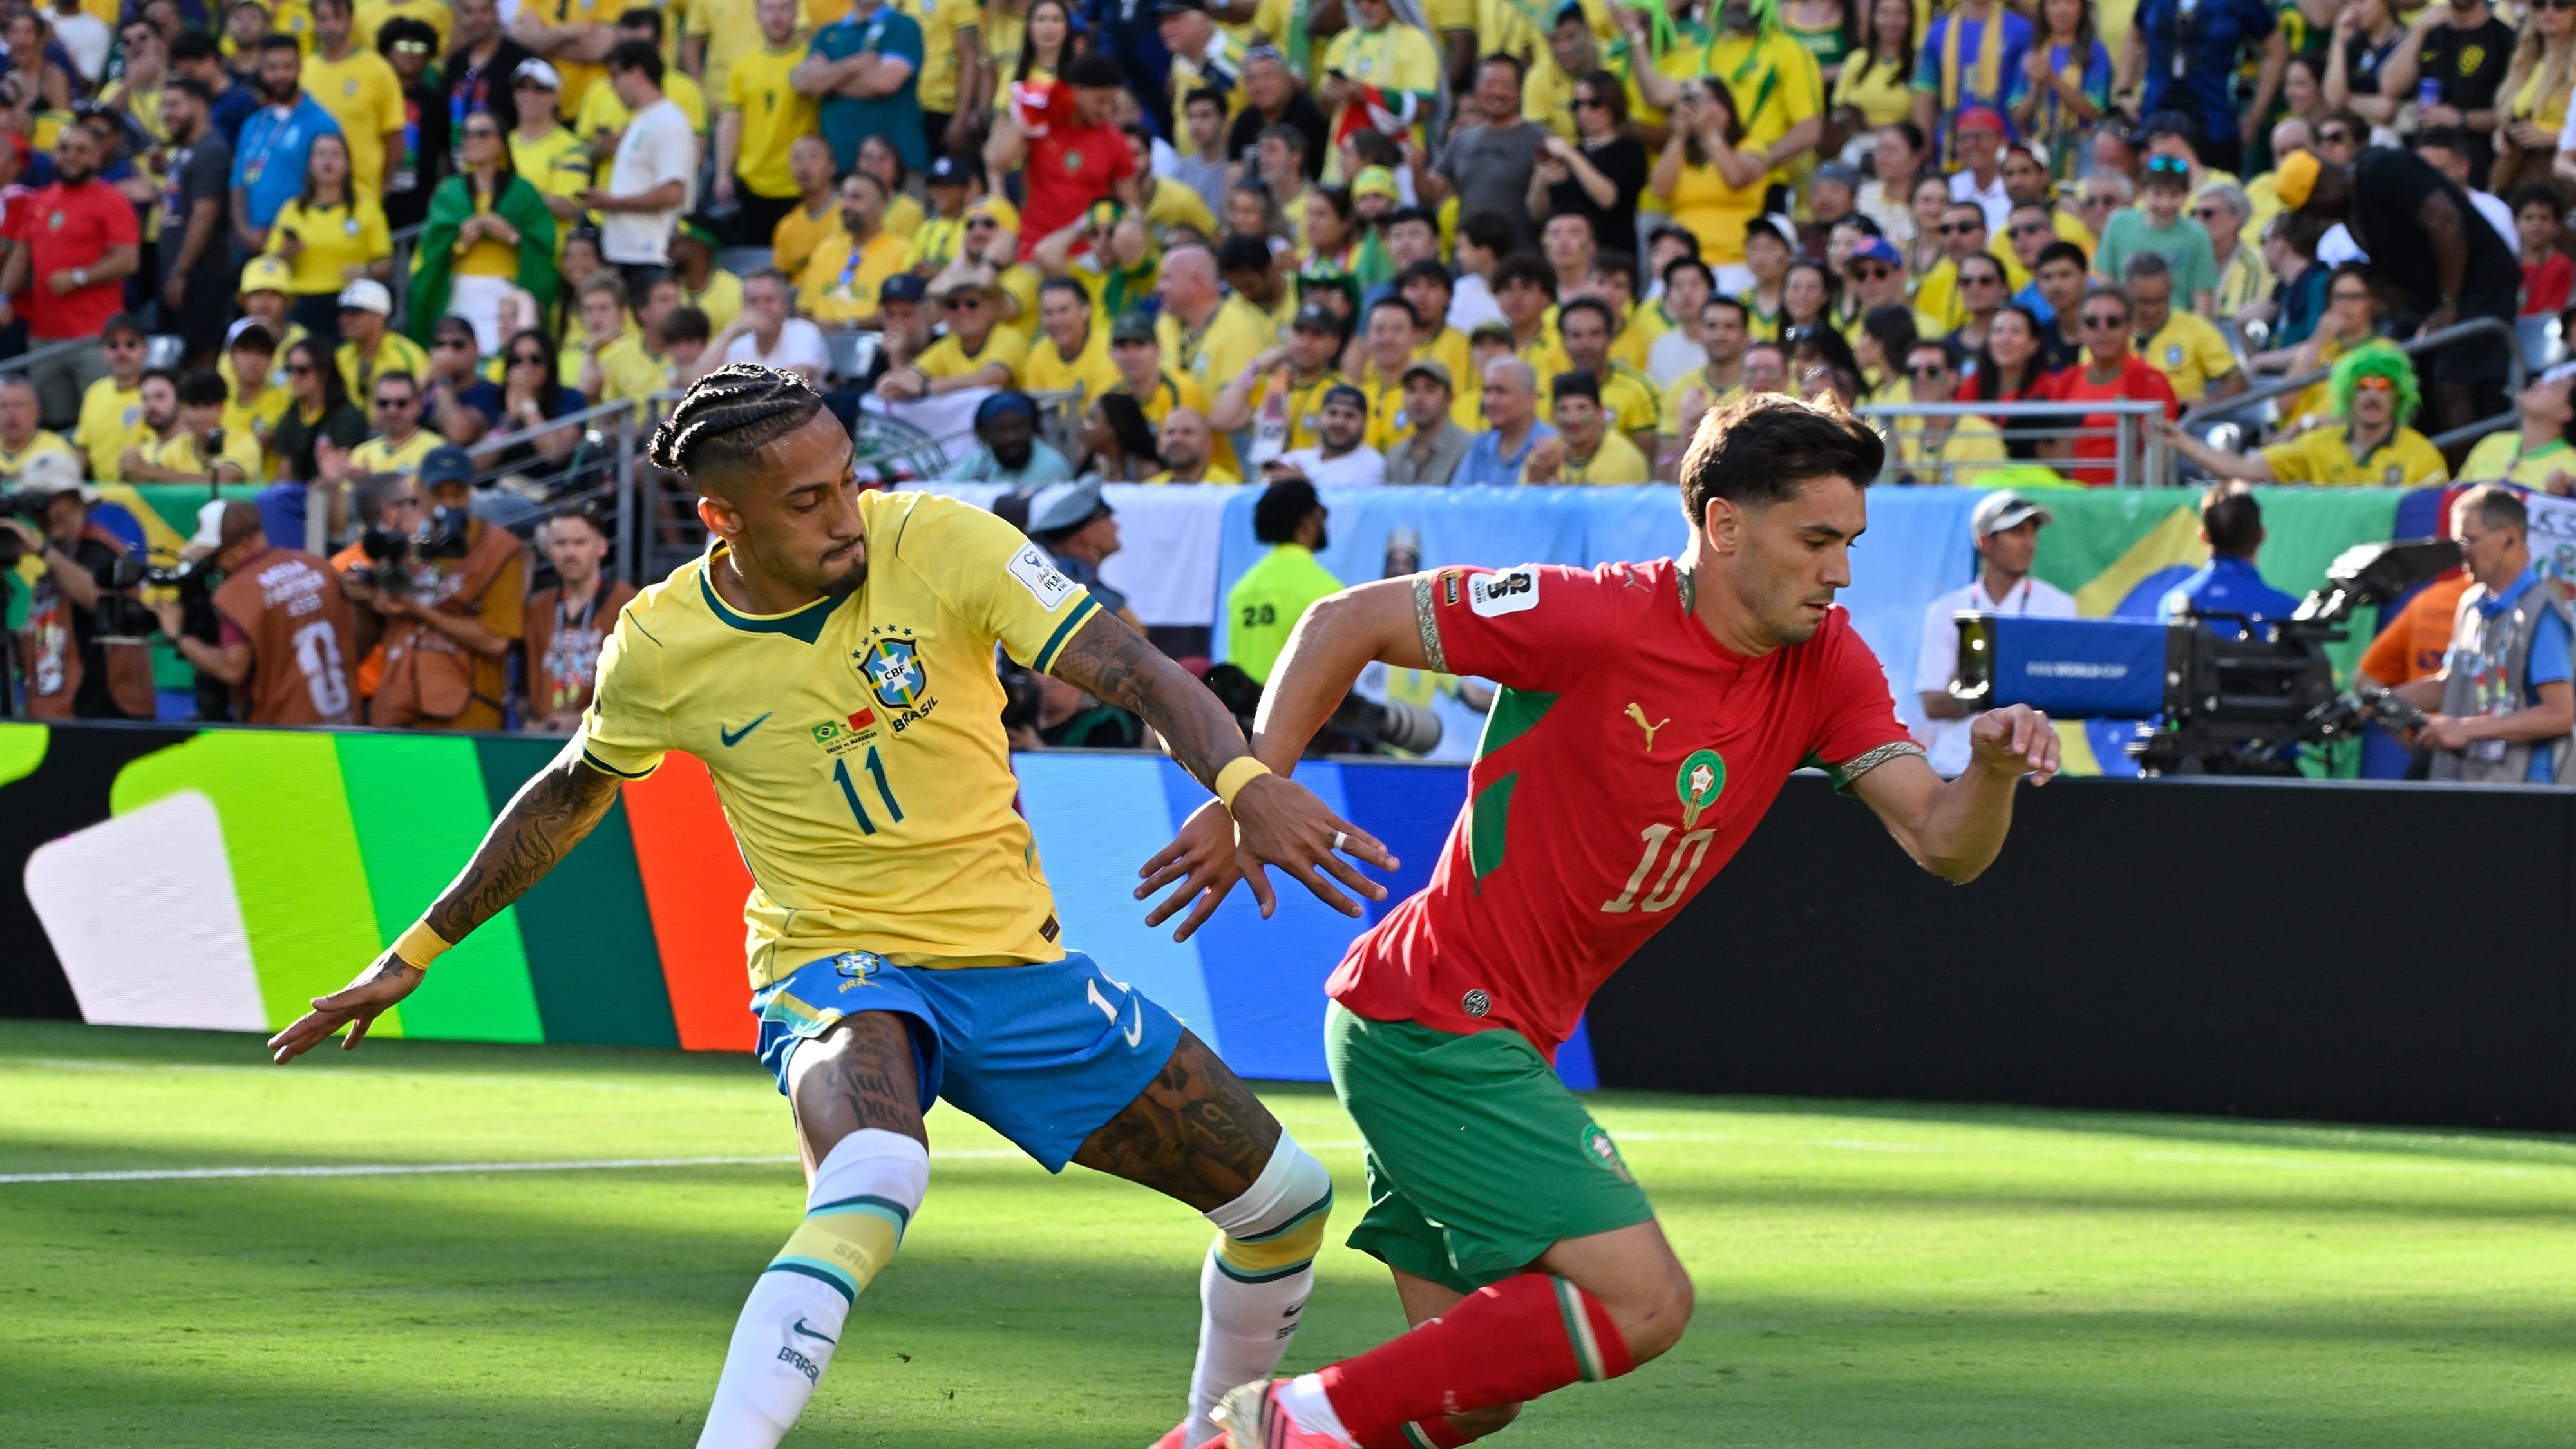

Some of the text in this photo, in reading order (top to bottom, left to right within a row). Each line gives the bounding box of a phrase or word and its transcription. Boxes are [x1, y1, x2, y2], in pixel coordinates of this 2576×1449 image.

[884, 664, 905, 681] CBF
[892, 696, 938, 733] BRASIL
[826, 744, 843, 754] BRASIL
[850, 731, 878, 744] MARROCOS
[833, 744, 904, 836] 11
[1600, 823, 1717, 912] 10
